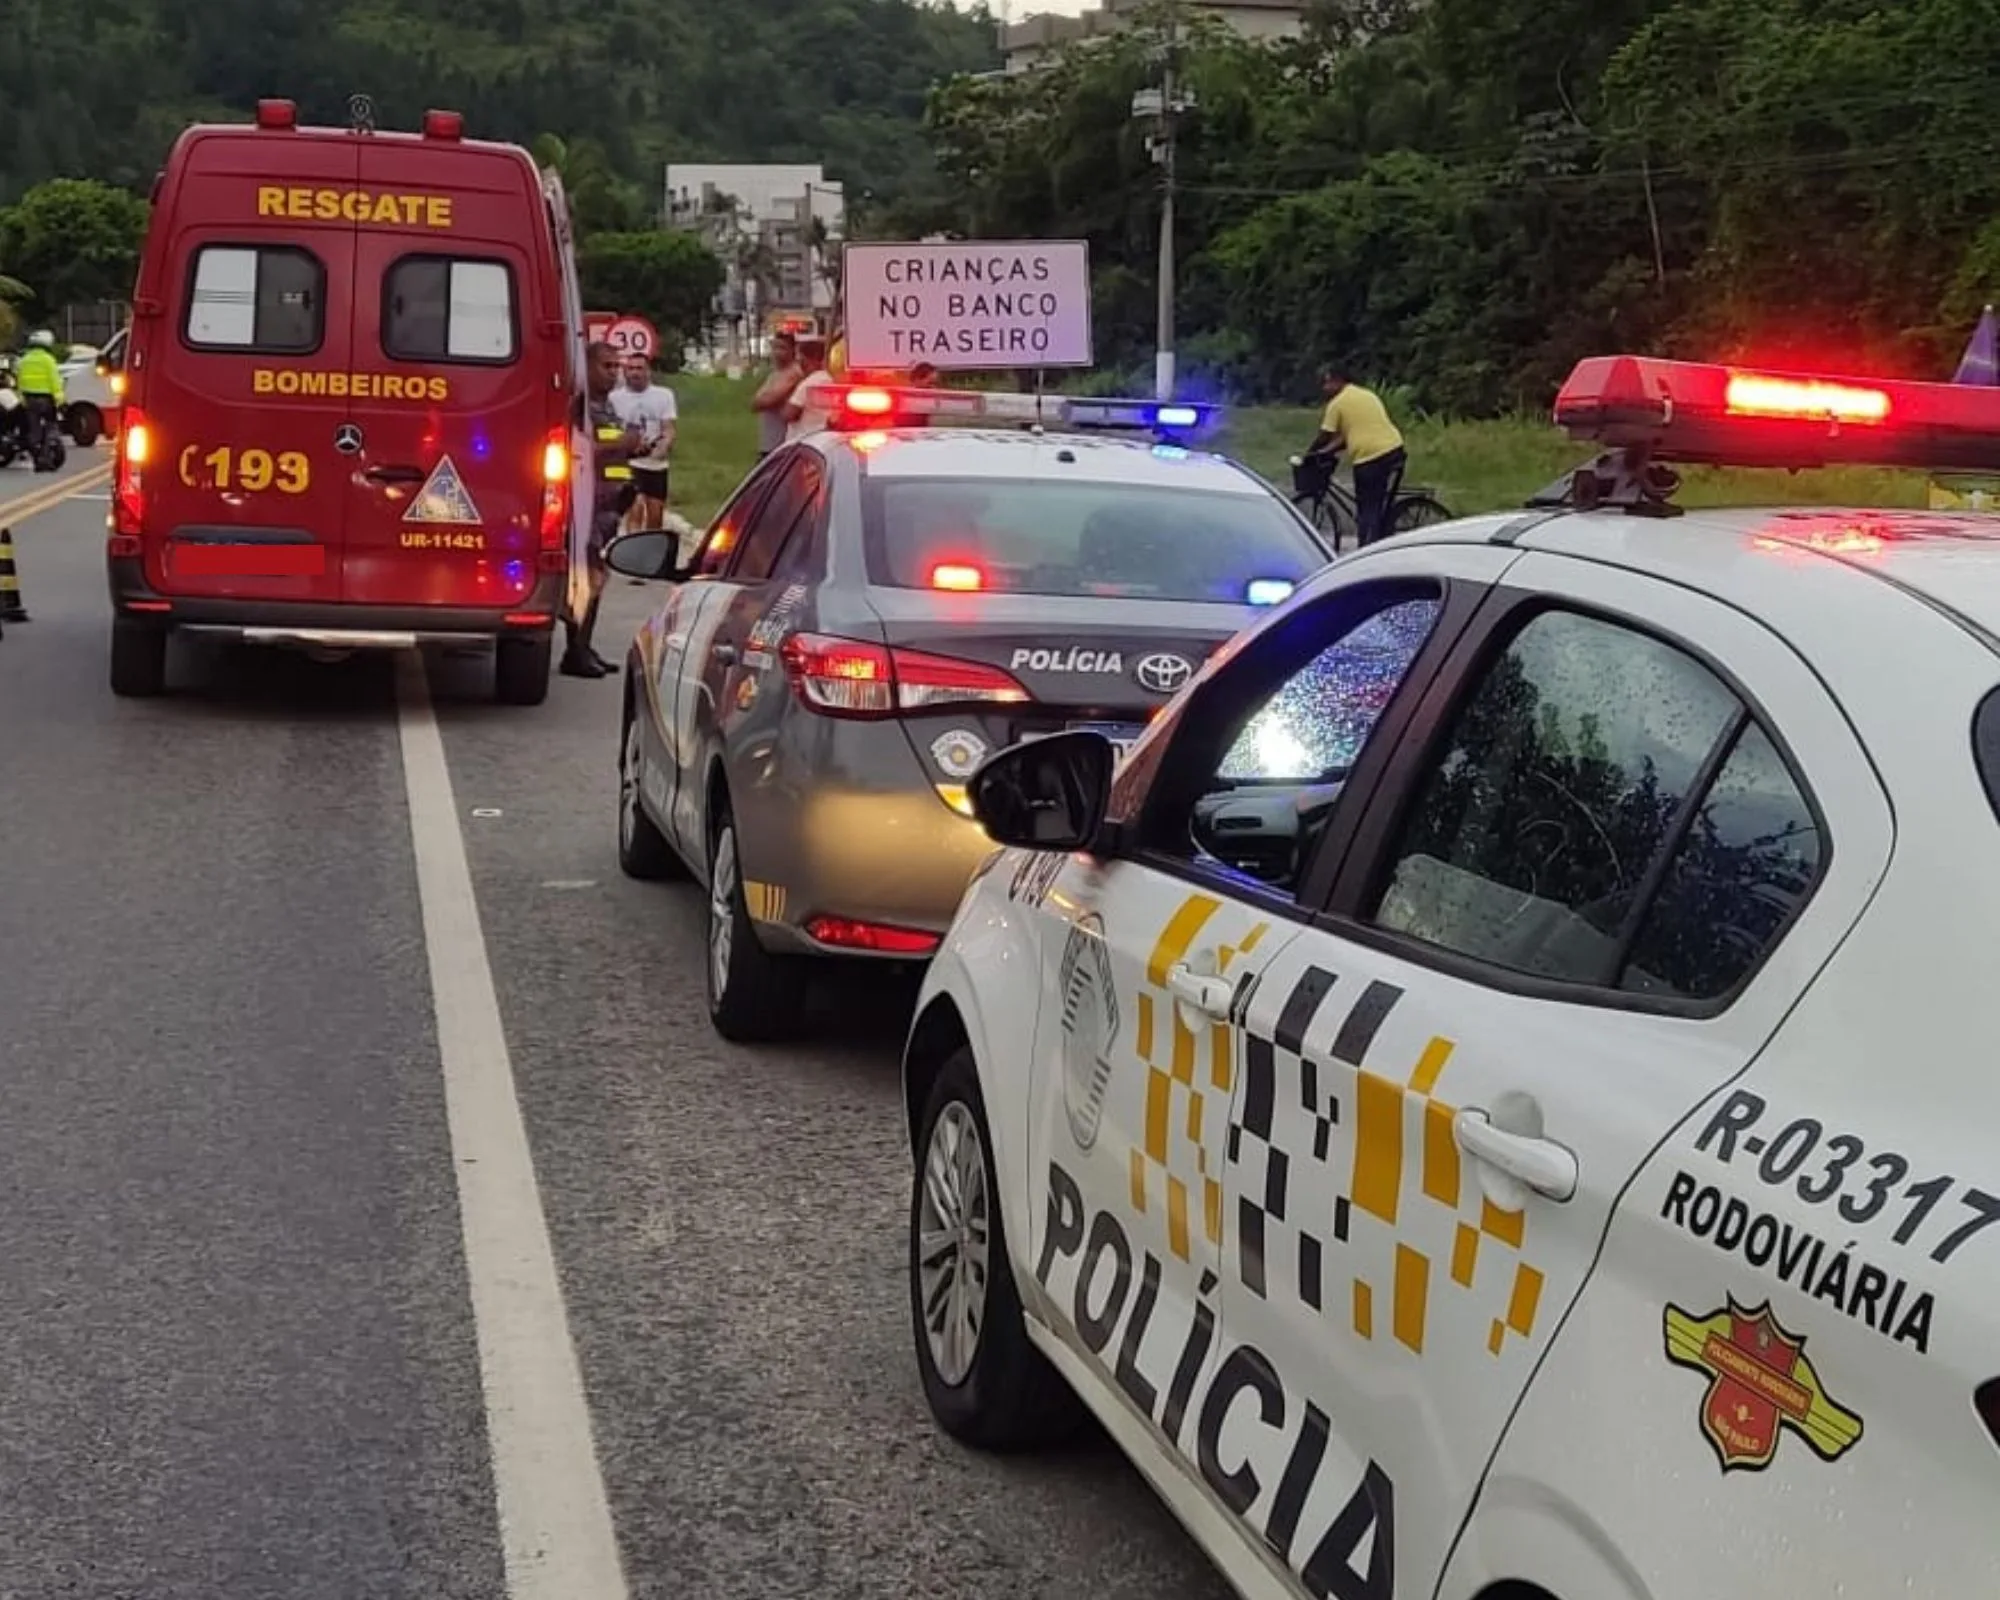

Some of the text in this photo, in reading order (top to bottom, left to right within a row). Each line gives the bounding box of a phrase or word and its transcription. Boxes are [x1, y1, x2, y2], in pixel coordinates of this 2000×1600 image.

[258, 187, 453, 227] RESGATE
[885, 257, 1050, 285] CRIANÇAS
[879, 293, 1058, 318] NO BANCO
[613, 331, 648, 351] 30
[890, 327, 1050, 353] TRASEIRO
[253, 369, 448, 401] BOMBEIROS
[205, 446, 310, 493] 193
[400, 532, 484, 550] UR-11421
[1010, 646, 1123, 675] POLÍCIA
[1694, 1089, 2000, 1264] R-03317
[1660, 1170, 1936, 1355] RODOVIÁRIA
[1037, 1161, 1396, 1600] POLÍCIA
